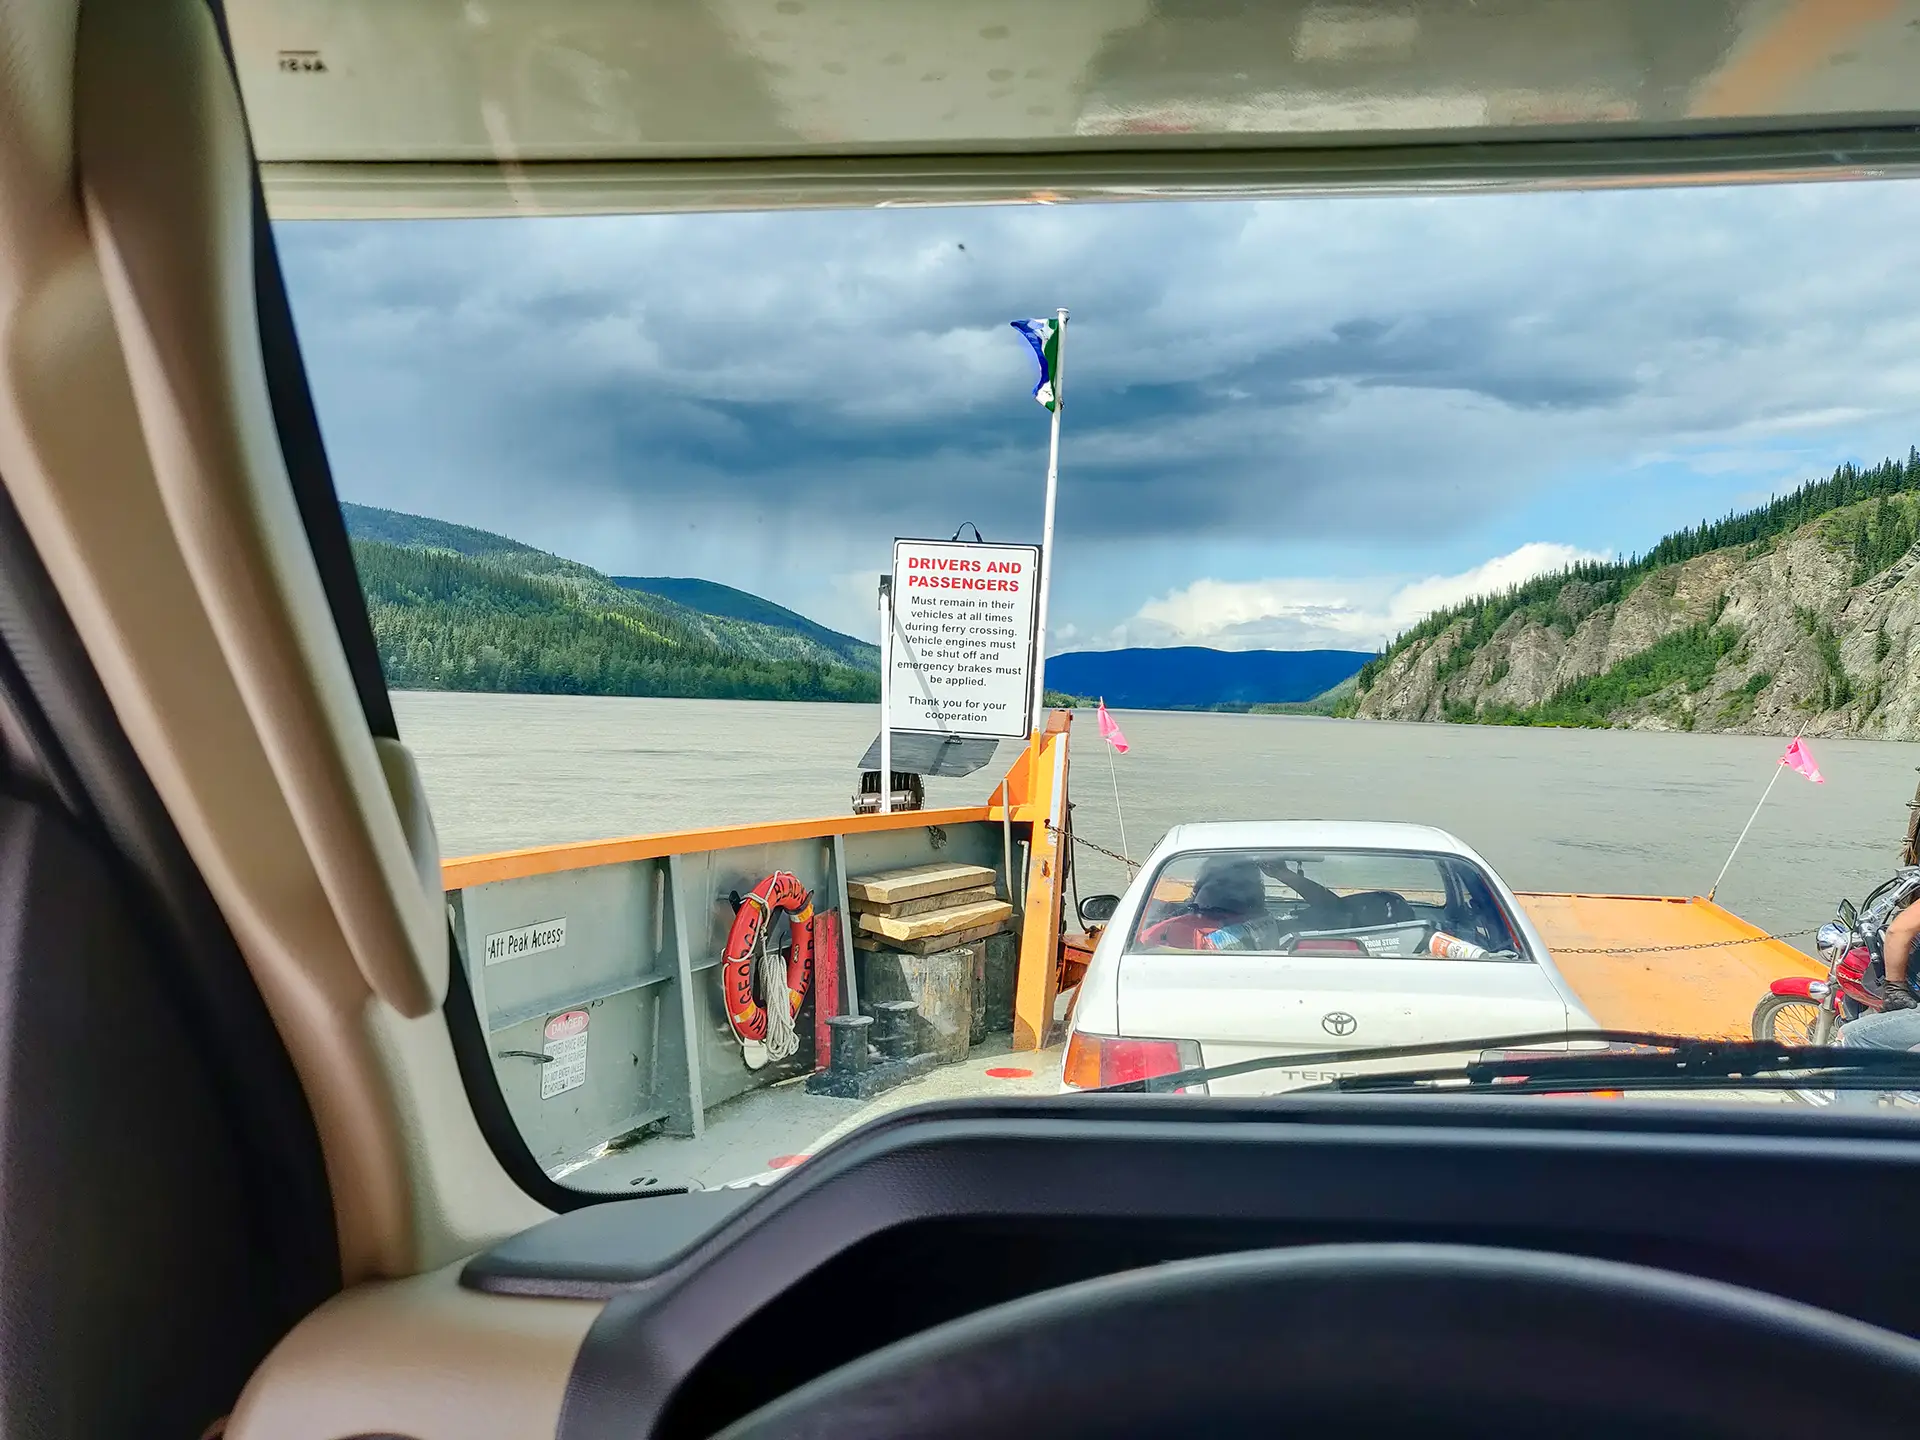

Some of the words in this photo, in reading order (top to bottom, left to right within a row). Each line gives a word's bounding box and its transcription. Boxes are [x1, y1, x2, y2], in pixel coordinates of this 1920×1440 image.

[908, 557, 981, 572] DRIVERS
[986, 561, 1022, 574] AND
[908, 575, 1019, 592] PASSENGERS
[911, 596, 937, 606] Must
[939, 598, 975, 608] remain
[978, 600, 988, 609] in
[991, 601, 1015, 610] their
[911, 610, 954, 620] vehicles
[956, 612, 967, 621] at
[969, 612, 982, 621] all
[984, 612, 1013, 623] times
[905, 622, 939, 634] during
[941, 623, 967, 635] ferry
[969, 626, 1018, 639] crossing.
[905, 635, 942, 646] Vehicle
[945, 638, 987, 649] engines
[990, 640, 1016, 649] must
[921, 648, 934, 657] be
[936, 649, 960, 659] shut
[962, 650, 977, 660] off
[979, 651, 999, 661] and
[897, 661, 954, 673] emergency
[957, 663, 993, 674] brakes
[995, 666, 1022, 675] must
[930, 674, 943, 684] be
[945, 675, 987, 687] applied.
[908, 695, 940, 706] Thank
[942, 697, 963, 709] you
[965, 698, 980, 708] for
[982, 701, 1007, 711] your
[925, 711, 988, 722] cooperation
[490, 937, 504, 959] Aft
[507, 931, 529, 955] Peak
[531, 927, 561, 949] Access
[551, 1016, 584, 1036] DANGER
